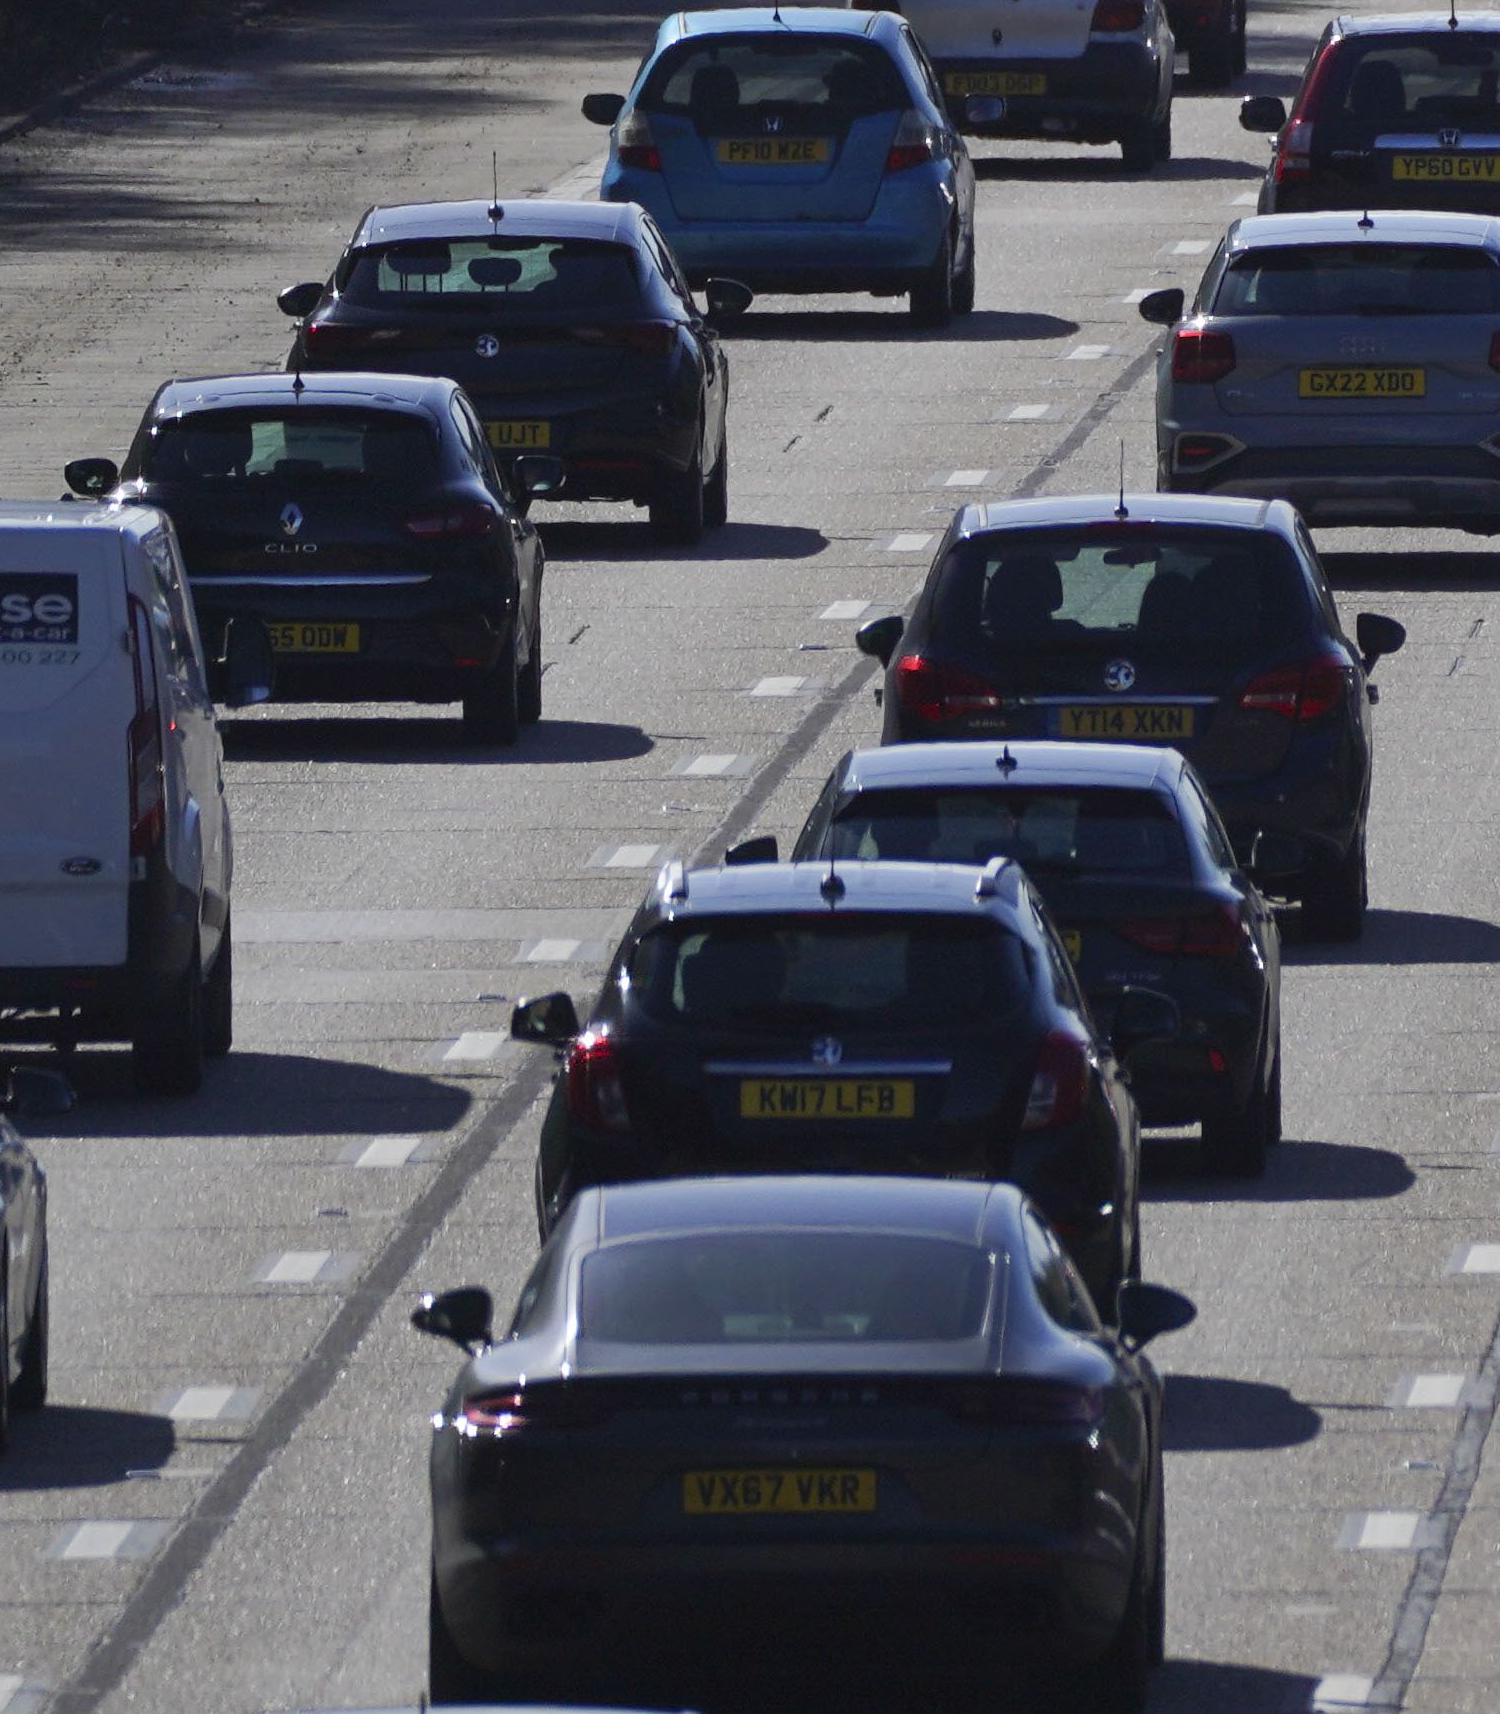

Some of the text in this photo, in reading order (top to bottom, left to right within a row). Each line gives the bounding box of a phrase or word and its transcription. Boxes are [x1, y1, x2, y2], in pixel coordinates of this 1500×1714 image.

[1402, 158, 1496, 176] YP60 GVV
[1310, 372, 1366, 392] GX22
[264, 543, 318, 554] CLIO
[1070, 709, 1183, 733] YT14 XKN
[759, 1087, 895, 1113] KW17 LFB
[696, 1475, 860, 1507] VX67 VKR
